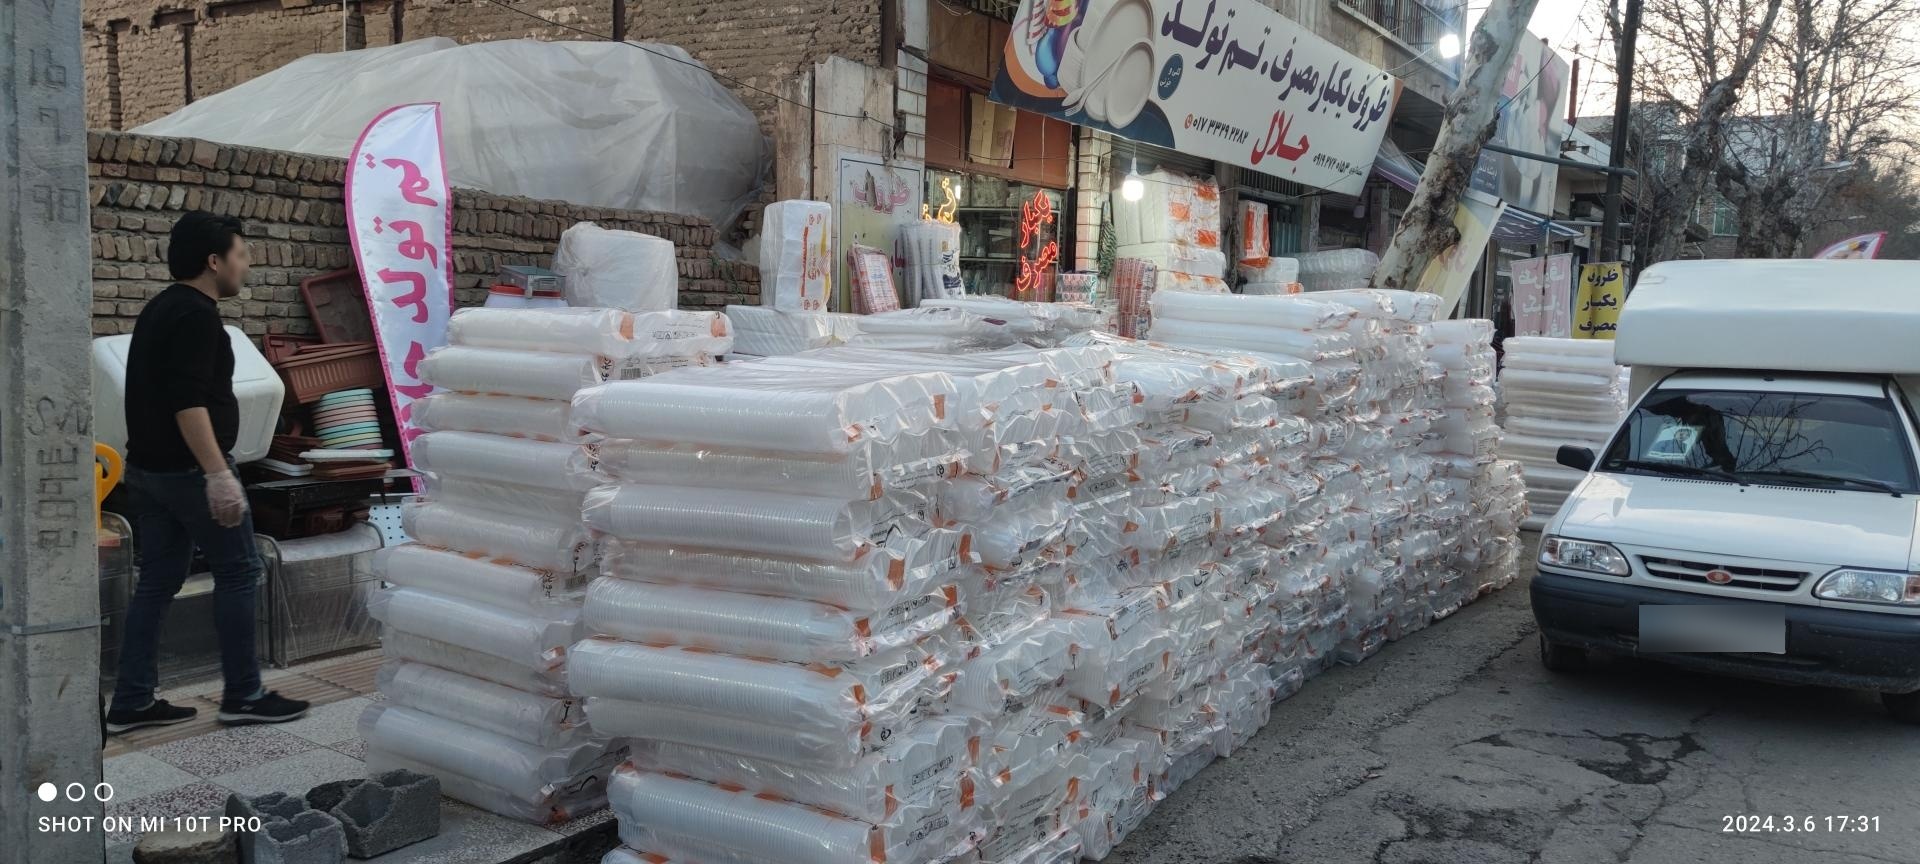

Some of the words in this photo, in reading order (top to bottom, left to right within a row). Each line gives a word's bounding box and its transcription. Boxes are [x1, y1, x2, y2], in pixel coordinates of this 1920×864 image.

[1161, 0, 1236, 70] تولد
[1218, 26, 1271, 76] تم
[1270, 37, 1320, 101] مصرف
[1308, 61, 1352, 119] یکبار
[1348, 75, 1389, 132] ظروف
[1250, 109, 1311, 175] جلال
[1020, 190, 1053, 249] یکبار
[1016, 240, 1058, 292] مصرف
[1578, 317, 1617, 336] مصرف
[1581, 293, 1618, 311] یکبار
